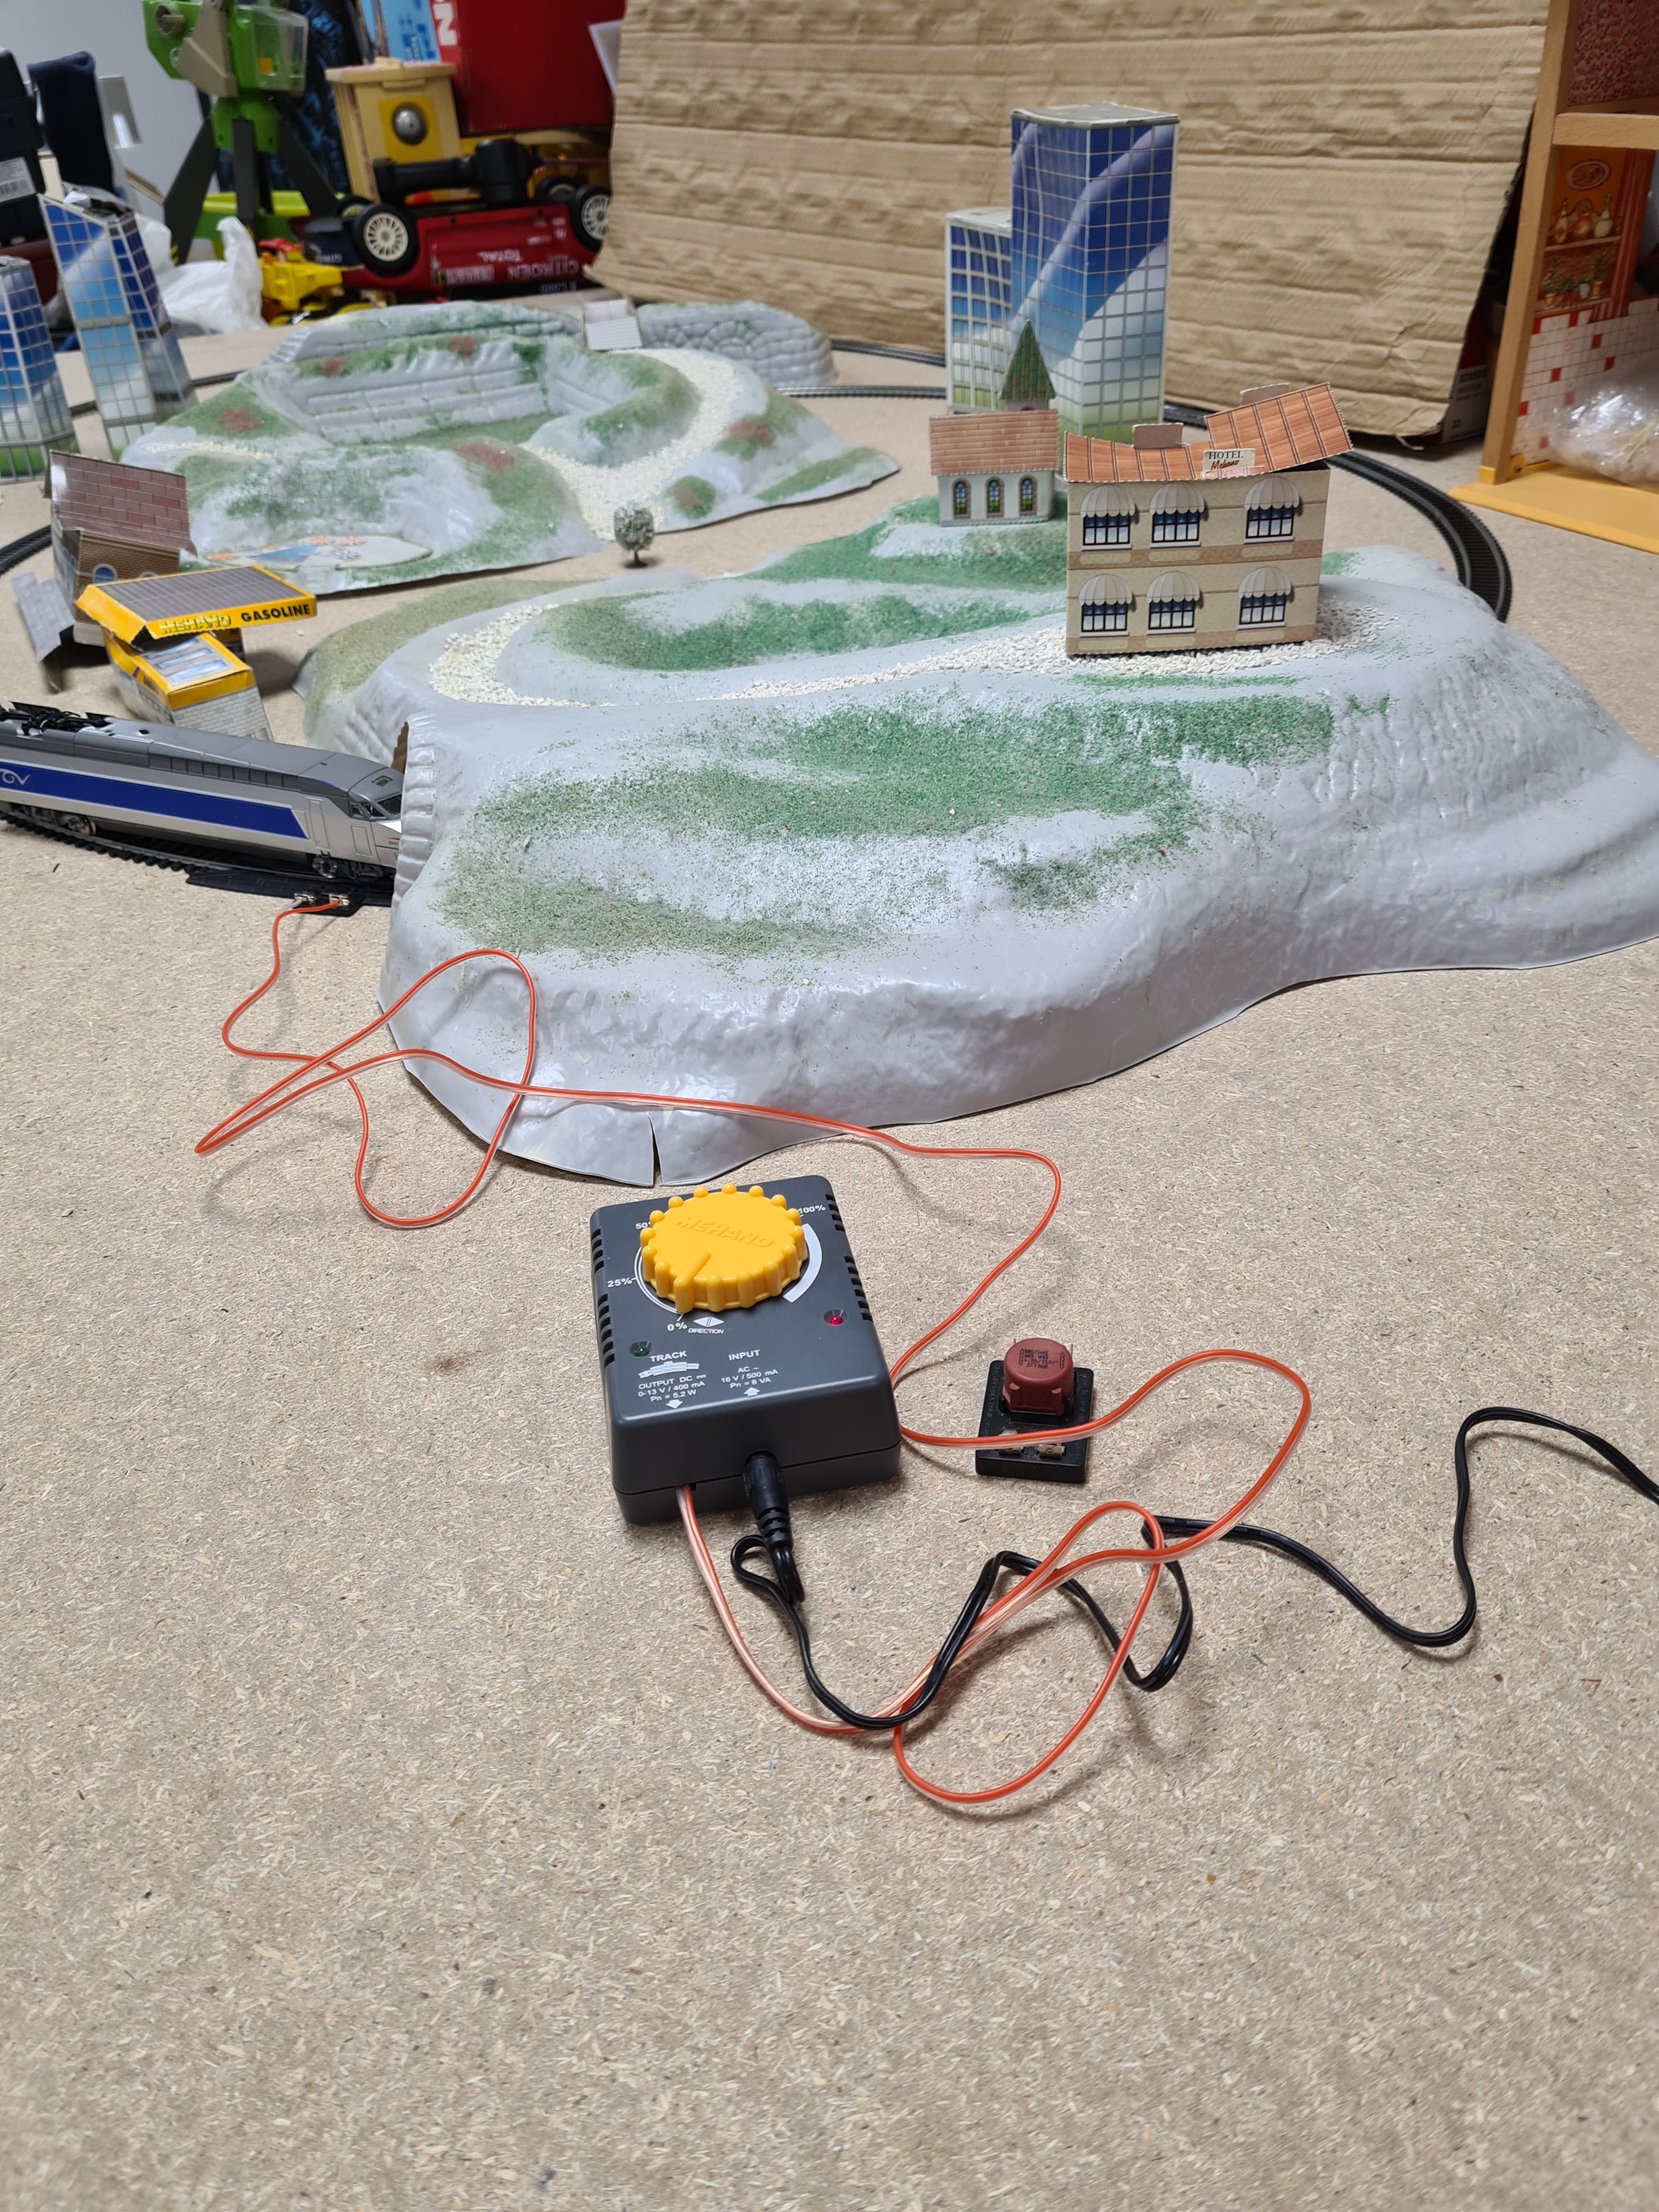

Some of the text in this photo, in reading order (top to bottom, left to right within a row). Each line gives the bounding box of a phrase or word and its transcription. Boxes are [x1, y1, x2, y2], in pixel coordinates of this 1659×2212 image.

[1209, 450, 1244, 460] HOTEL
[241, 603, 311, 623] GASOLINE
[798, 1204, 826, 1214] 100%
[674, 1216, 775, 1248] MEHANO
[607, 1278, 633, 1288] 25%
[667, 1322, 687, 1331] 0%
[650, 1351, 687, 1362] TRACK
[728, 1350, 760, 1361] INPUT
[638, 1378, 675, 1390] OUTPUT
